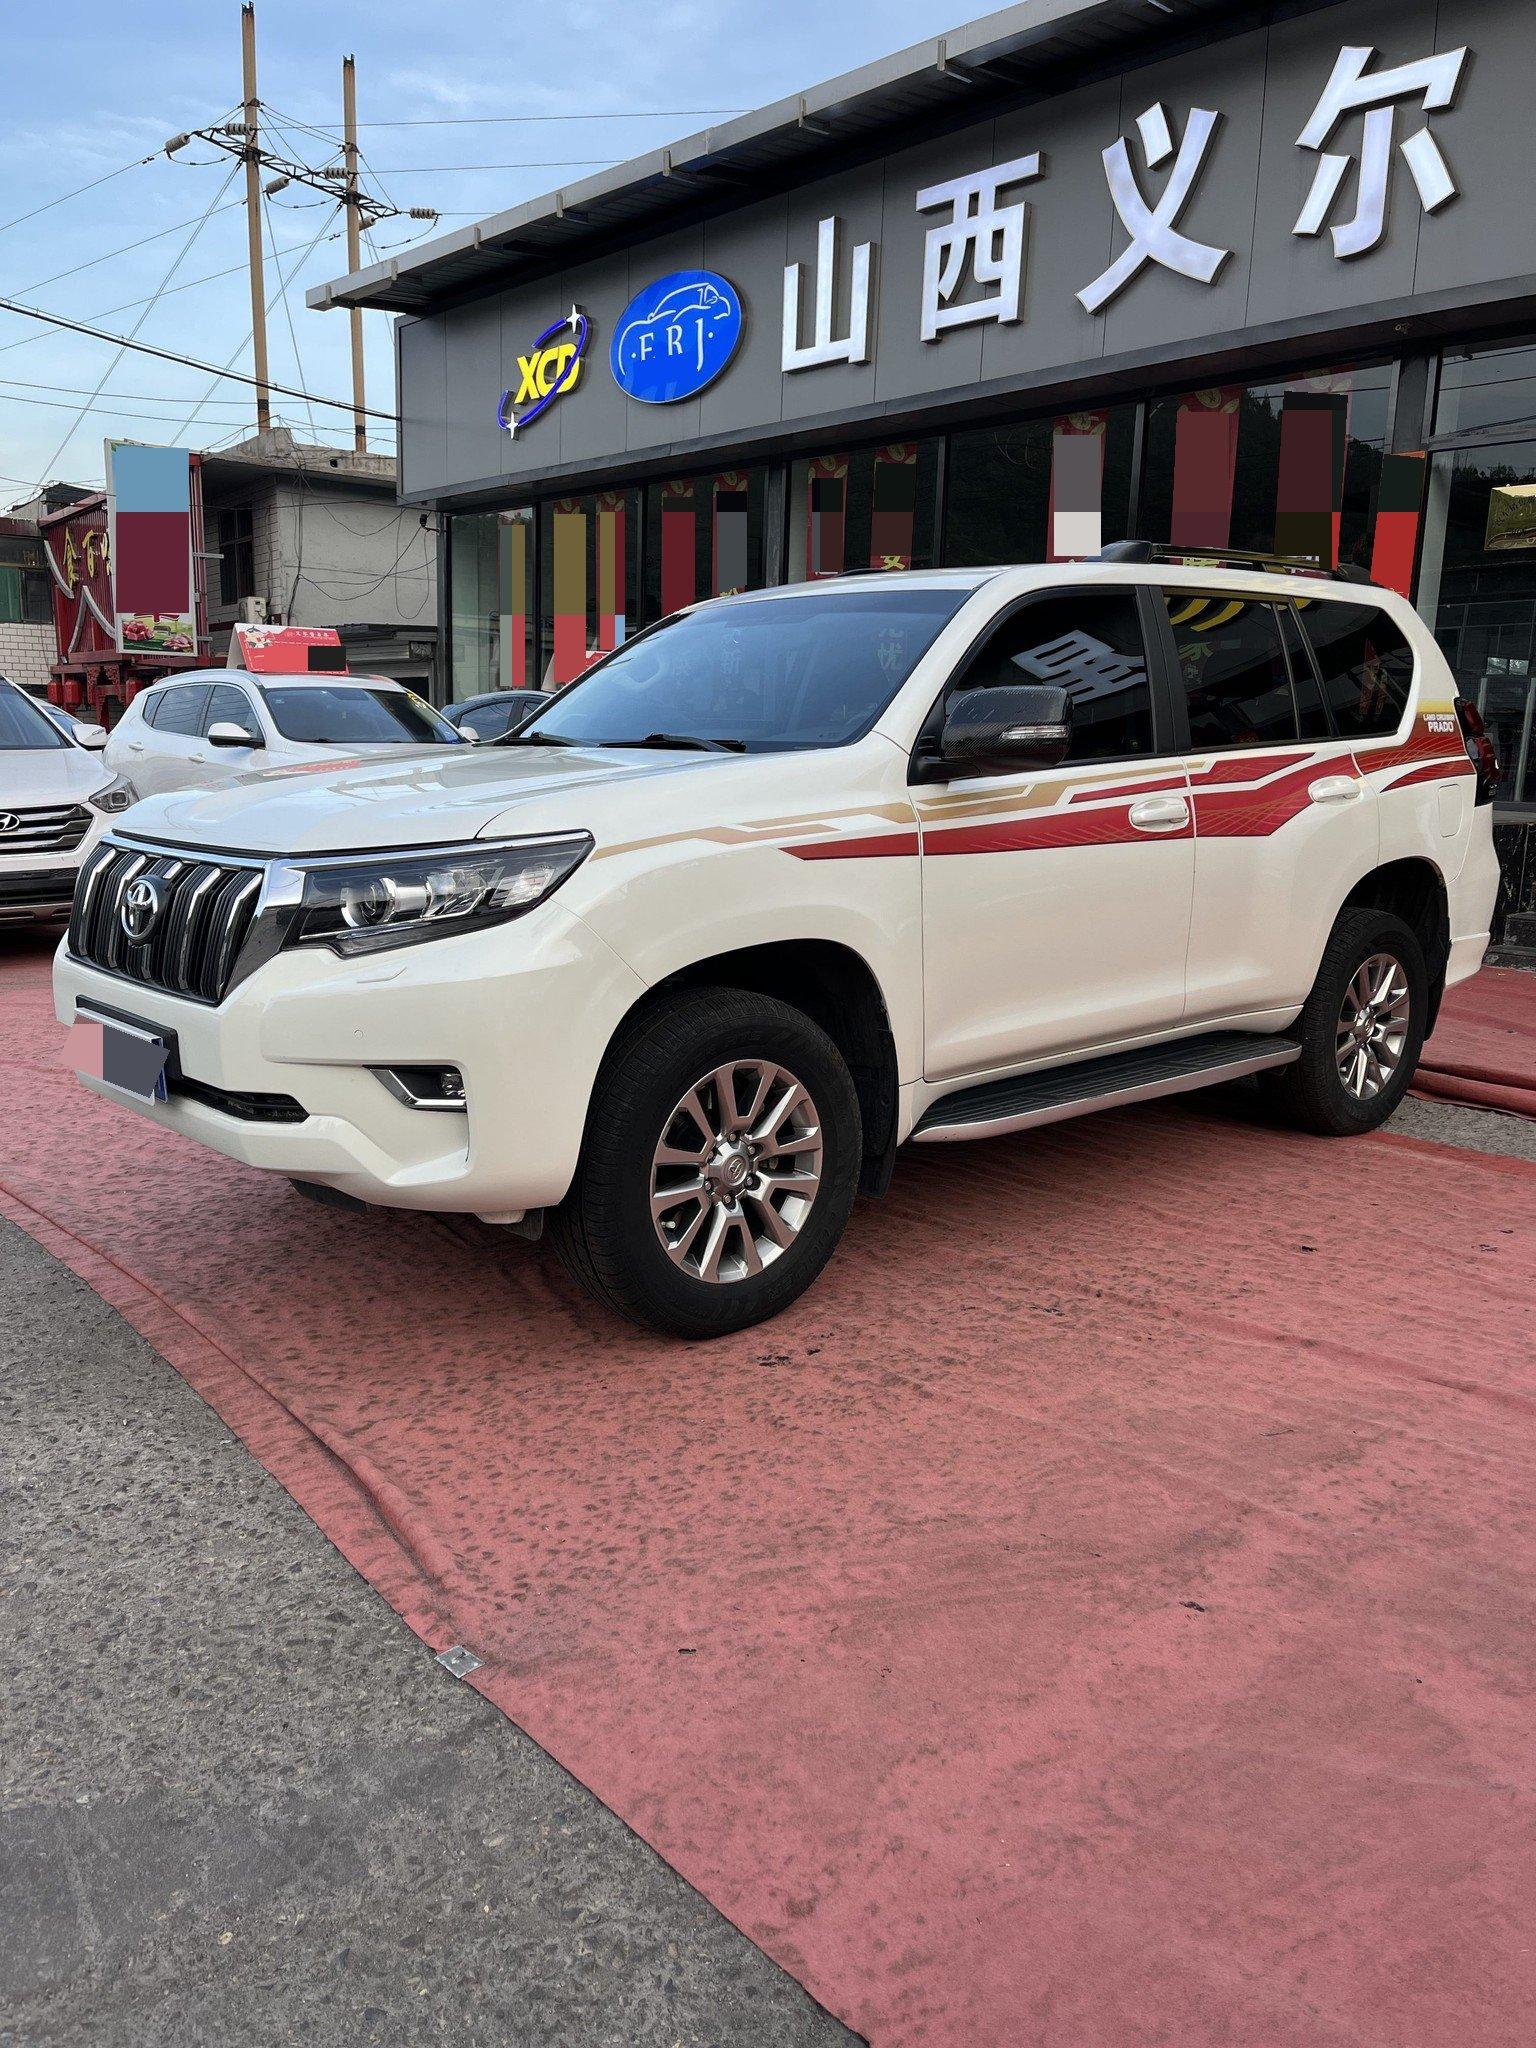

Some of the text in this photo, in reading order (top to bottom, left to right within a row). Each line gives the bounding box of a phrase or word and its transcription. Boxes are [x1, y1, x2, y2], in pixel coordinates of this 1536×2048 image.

[782, 45, 1470, 374] 山西义尔
[514, 343, 580, 405] XCD
[1428, 721, 1454, 732] PRADO
